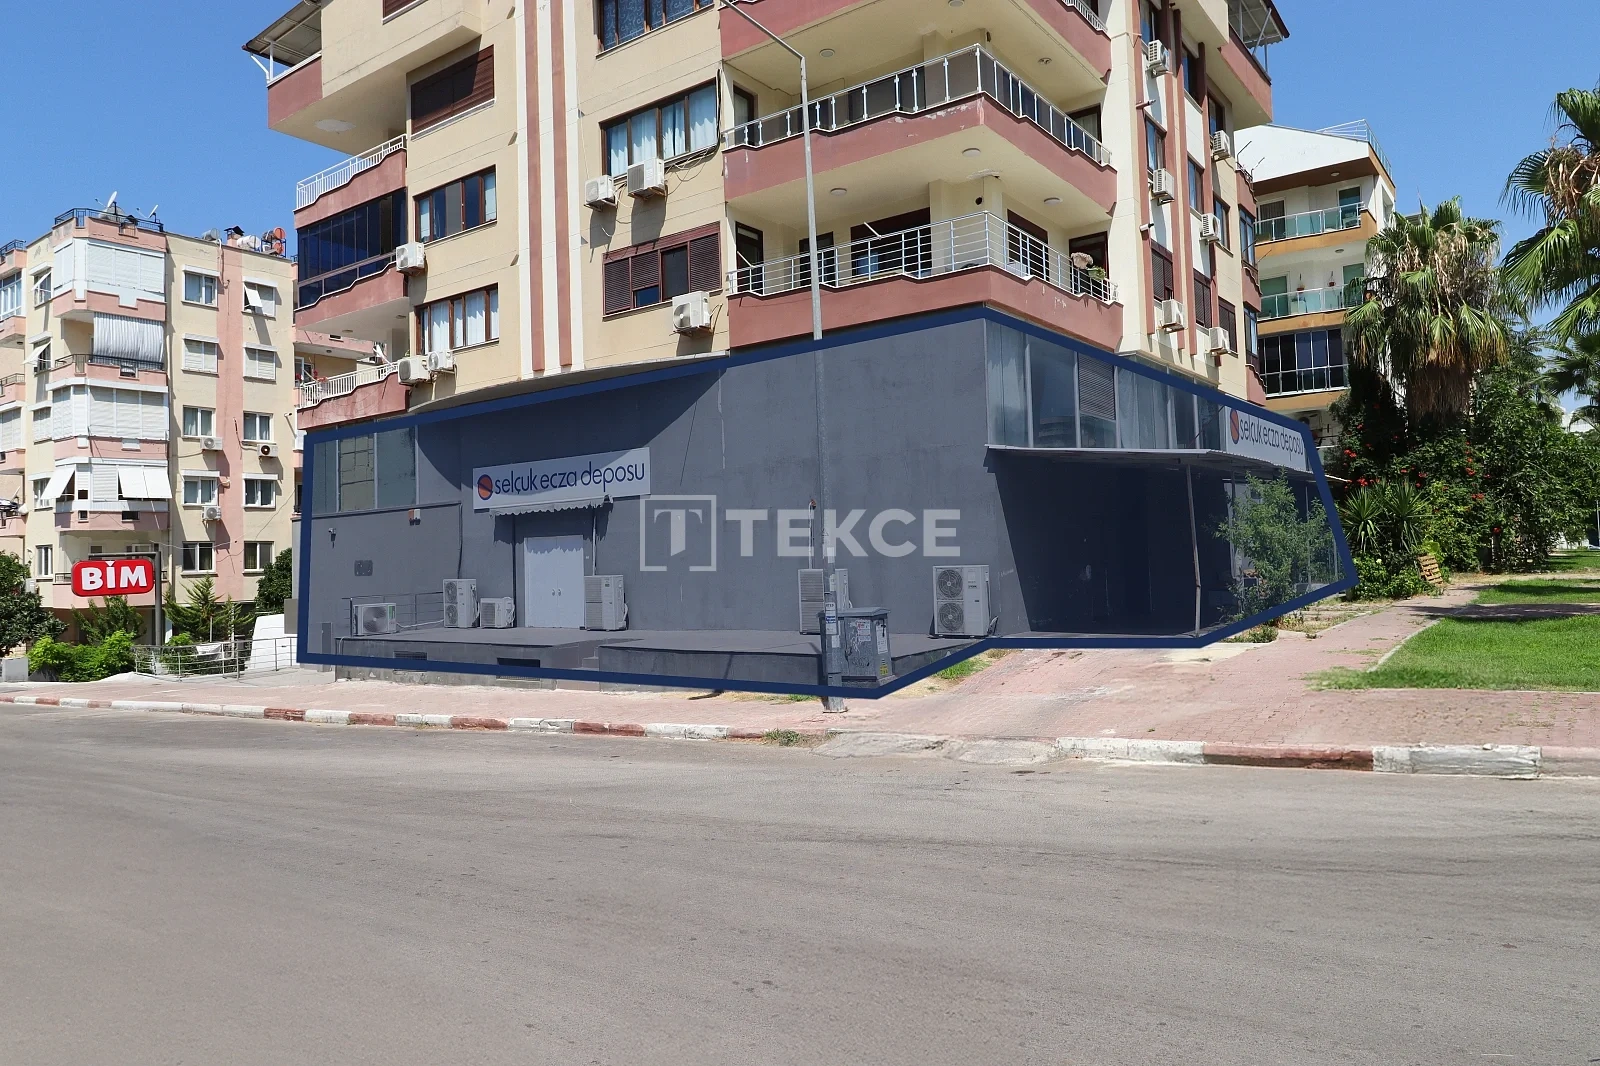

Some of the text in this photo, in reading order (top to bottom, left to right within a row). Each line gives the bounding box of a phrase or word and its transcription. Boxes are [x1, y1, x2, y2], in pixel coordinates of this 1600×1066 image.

[1240, 416, 1304, 461] selçuk ecza deposu
[494, 461, 645, 495] selçuk ecza deposu
[81, 560, 147, 591] BİM
